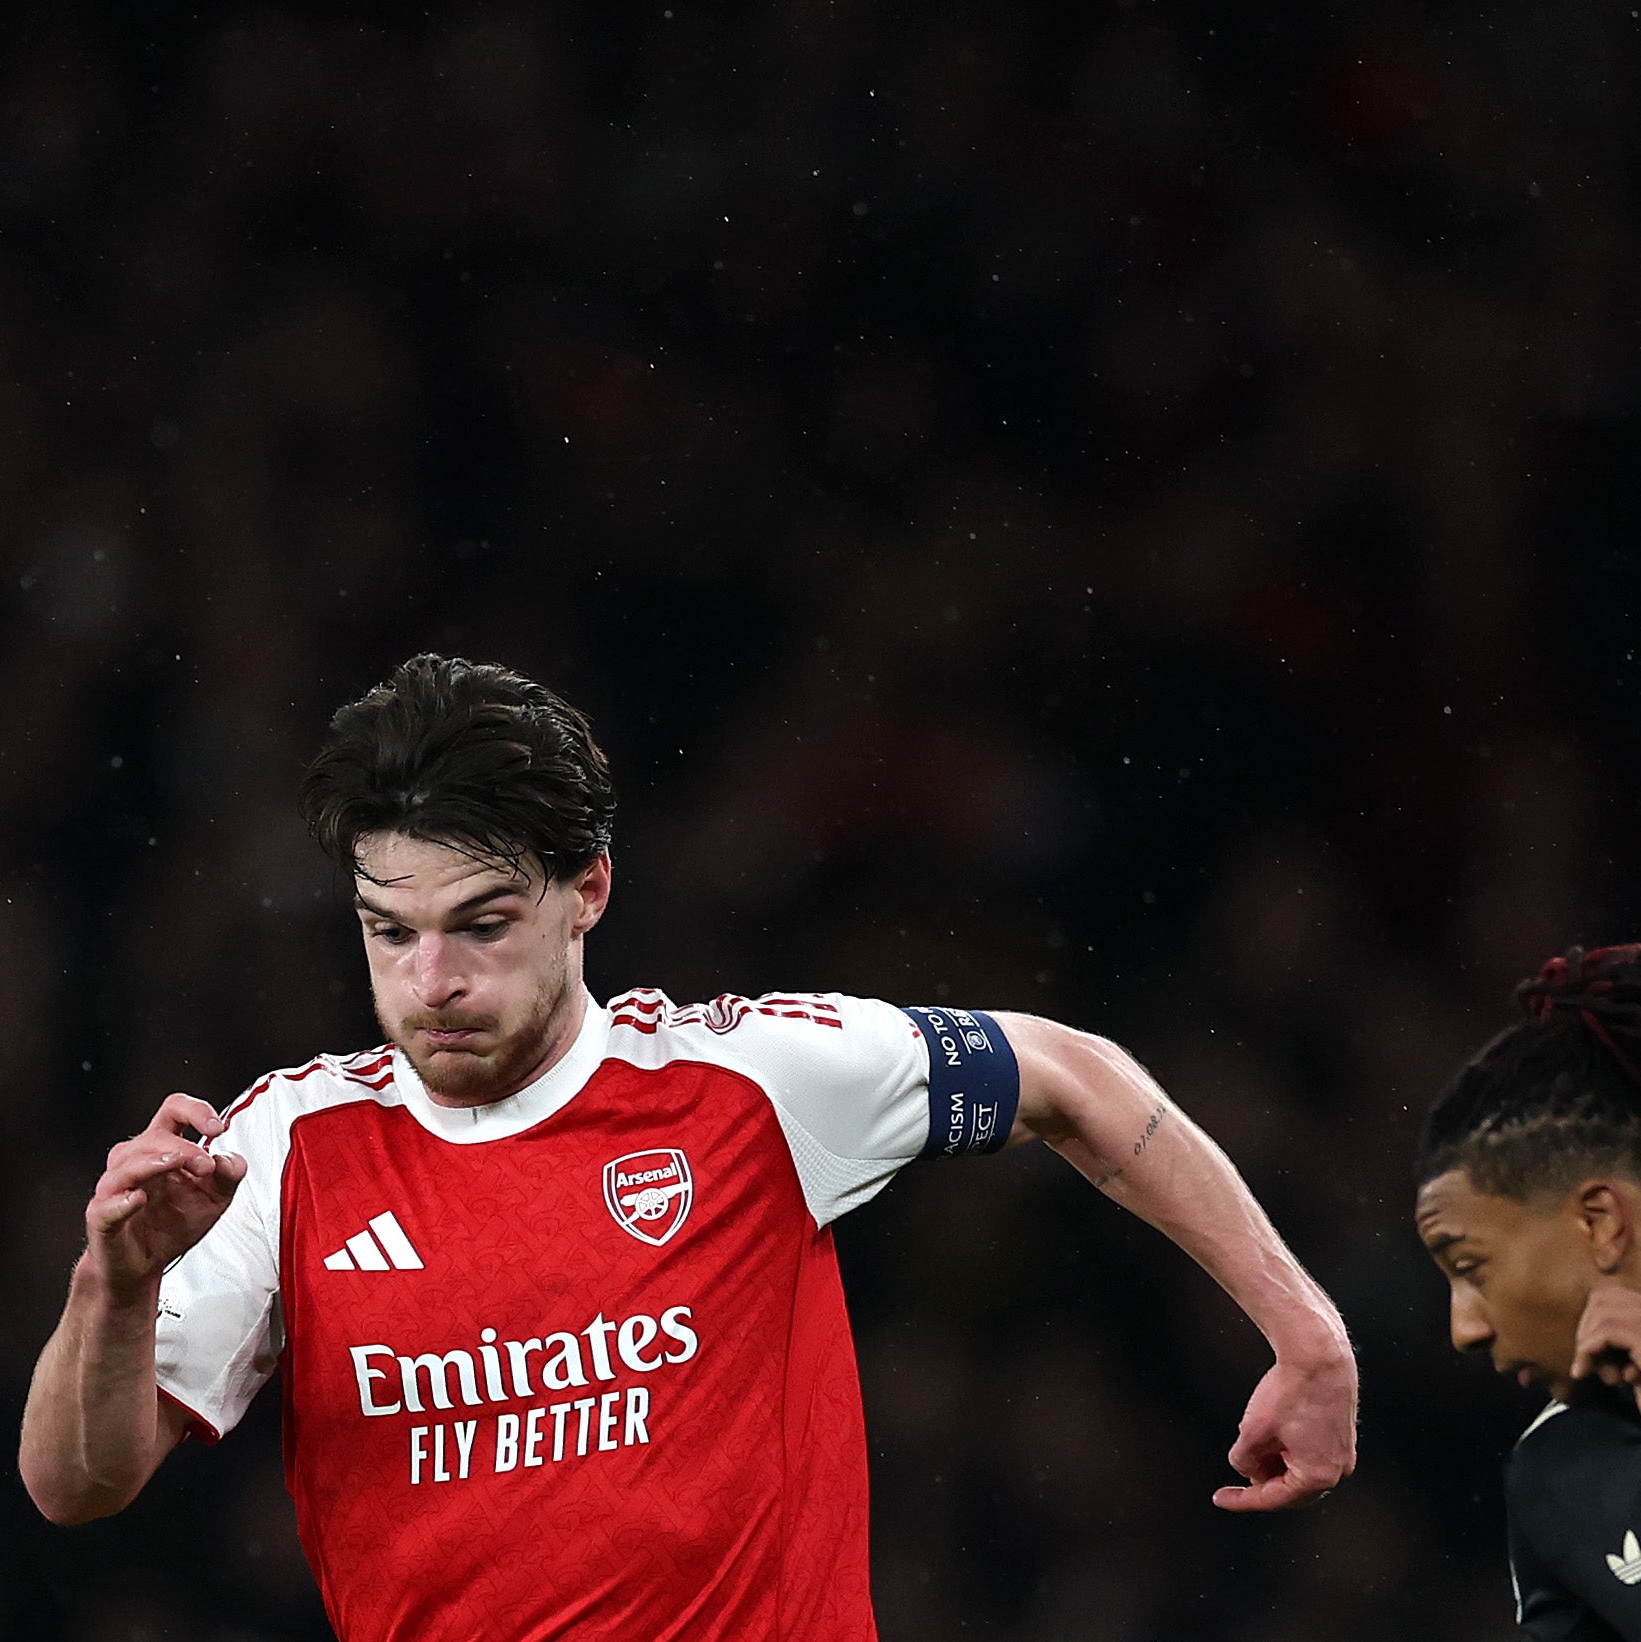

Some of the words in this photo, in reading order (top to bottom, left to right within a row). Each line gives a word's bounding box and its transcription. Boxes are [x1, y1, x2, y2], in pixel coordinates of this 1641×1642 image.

[927, 1013, 949, 1034] TO
[941, 1036, 962, 1066] NO
[943, 1093, 965, 1155] ACISM
[616, 1162, 678, 1188] Arsenal
[349, 1305, 699, 1417] Emirates
[411, 1419, 478, 1486] FLY
[494, 1386, 651, 1474] BETTER
